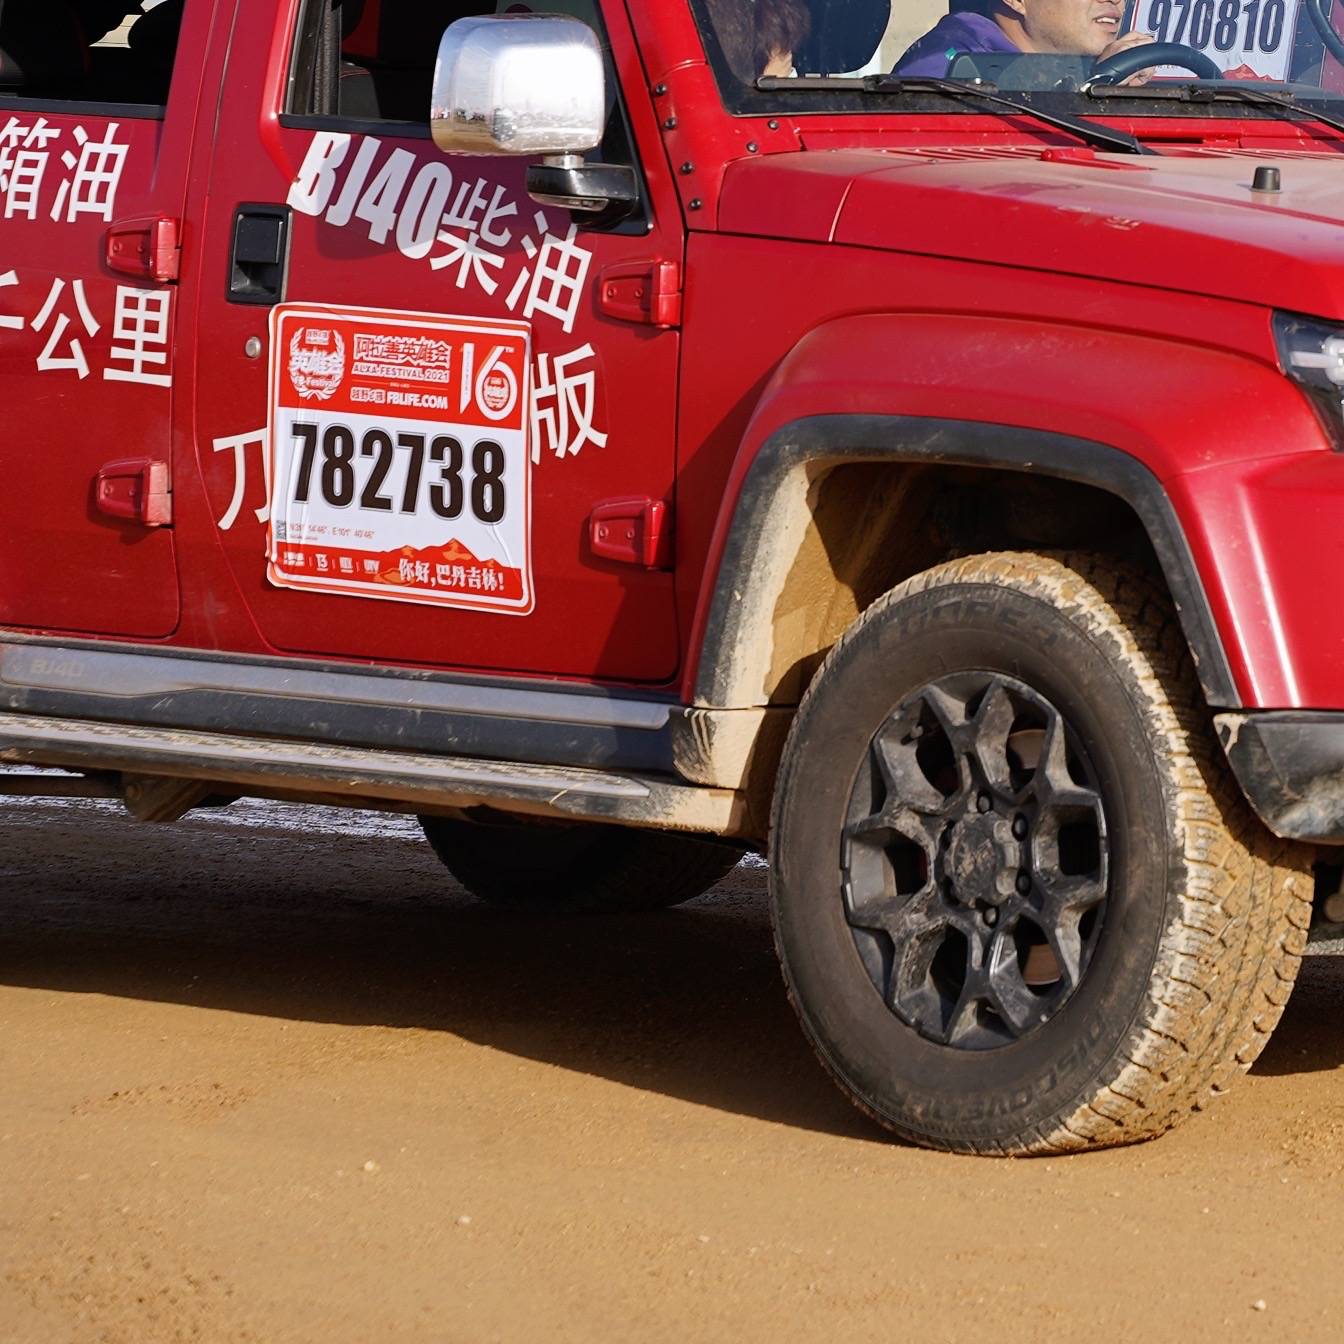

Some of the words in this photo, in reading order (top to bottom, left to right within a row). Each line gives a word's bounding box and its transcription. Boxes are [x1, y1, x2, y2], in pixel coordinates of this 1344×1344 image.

[0, 117, 130, 223] 箱油
[353, 334, 452, 369] 阿拉善英雄会
[425, 369, 450, 383] 2021
[387, 391, 449, 410] FBLIFE.COM
[290, 421, 508, 525] 782738
